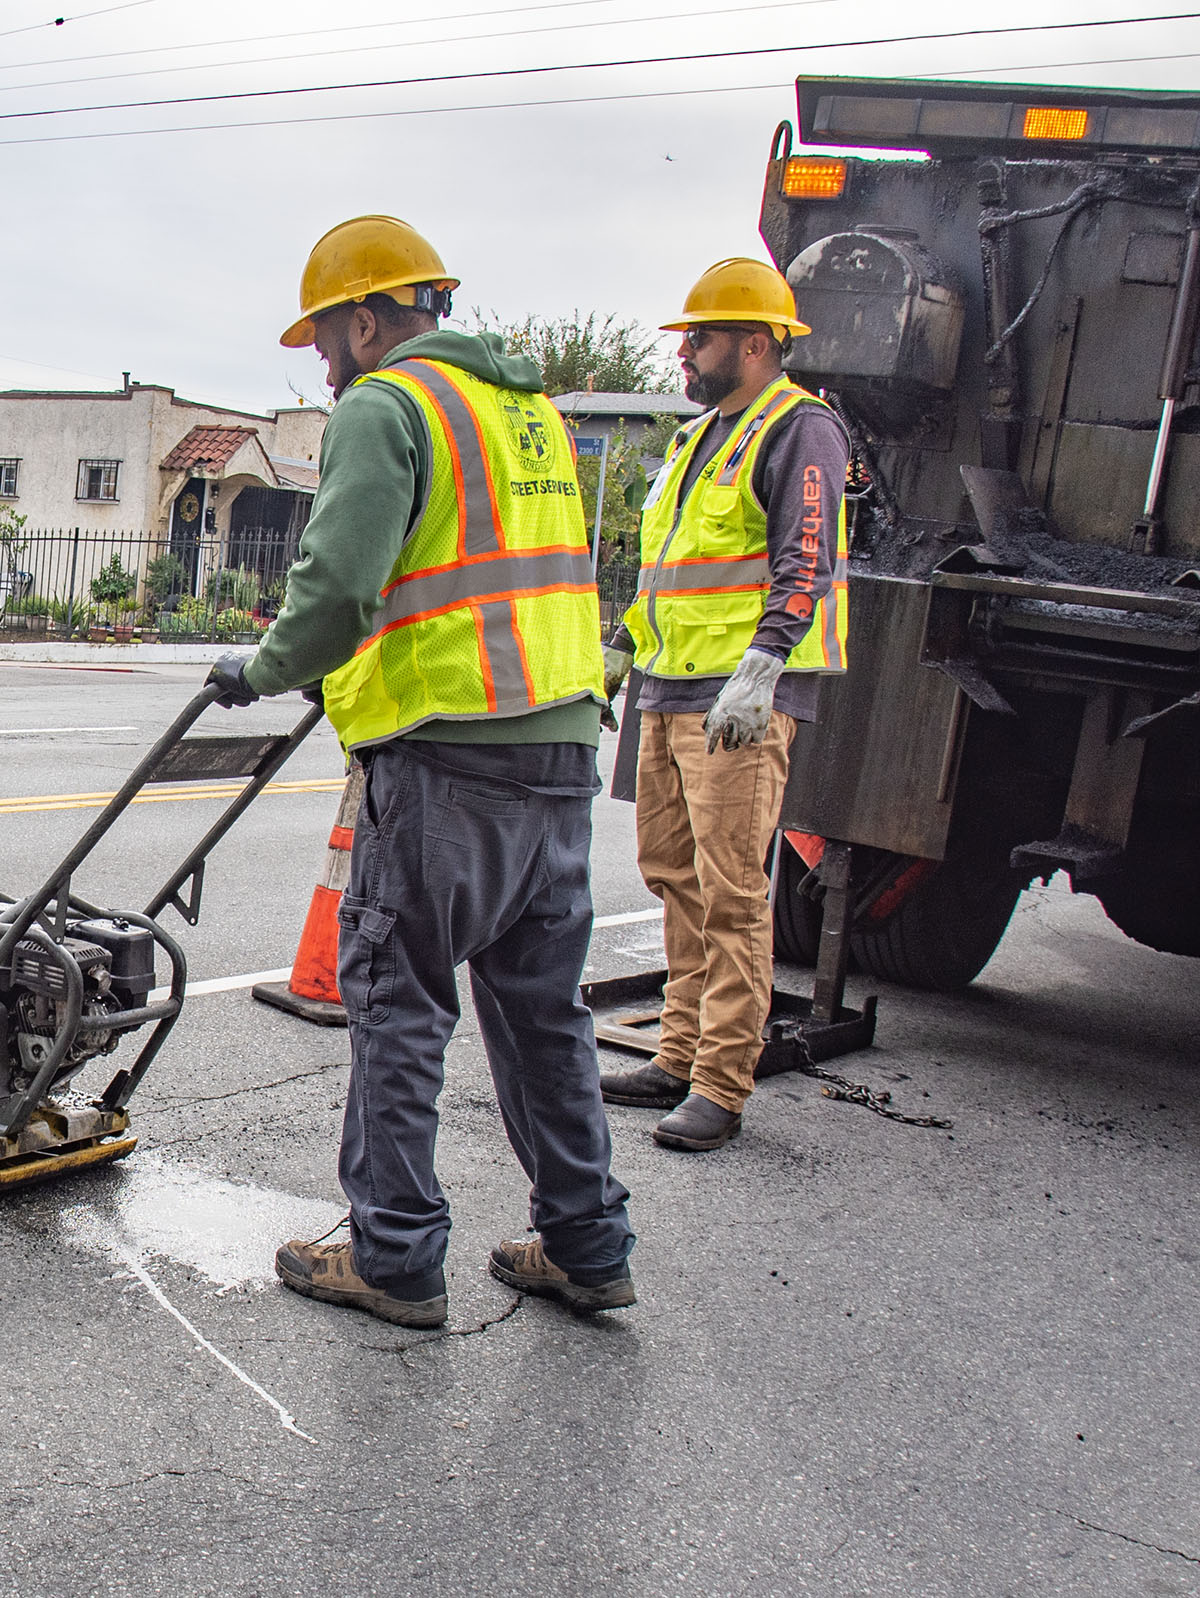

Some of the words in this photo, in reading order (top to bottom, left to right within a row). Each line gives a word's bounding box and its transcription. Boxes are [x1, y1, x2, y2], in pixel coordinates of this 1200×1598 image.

[578, 446, 593, 455] 2300
[510, 480, 539, 496] STEET
[795, 464, 824, 592] carhartt
